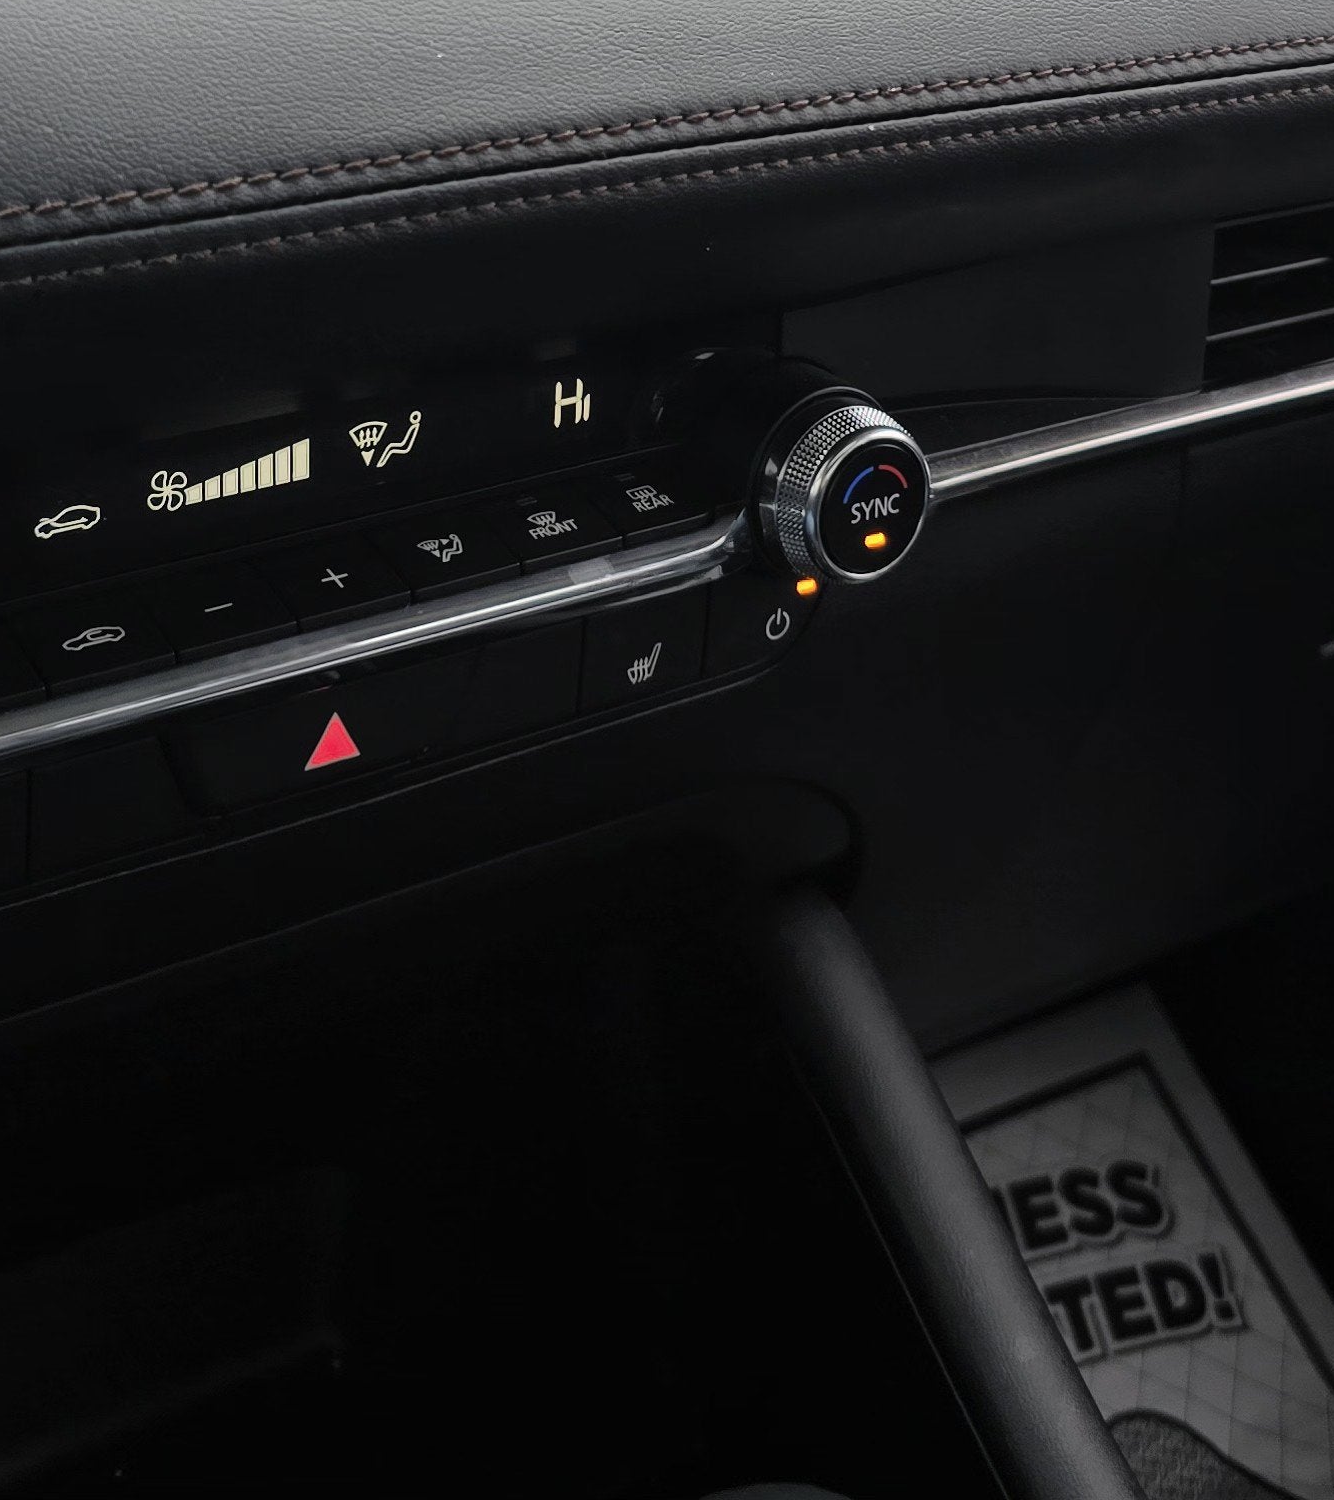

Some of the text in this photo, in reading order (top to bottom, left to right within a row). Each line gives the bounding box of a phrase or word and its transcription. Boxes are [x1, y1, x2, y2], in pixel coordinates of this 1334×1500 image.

[632, 494, 675, 513] REAR
[850, 492, 901, 525] SYNC
[528, 518, 579, 540] FRONT
[991, 1160, 1165, 1250] ESS
